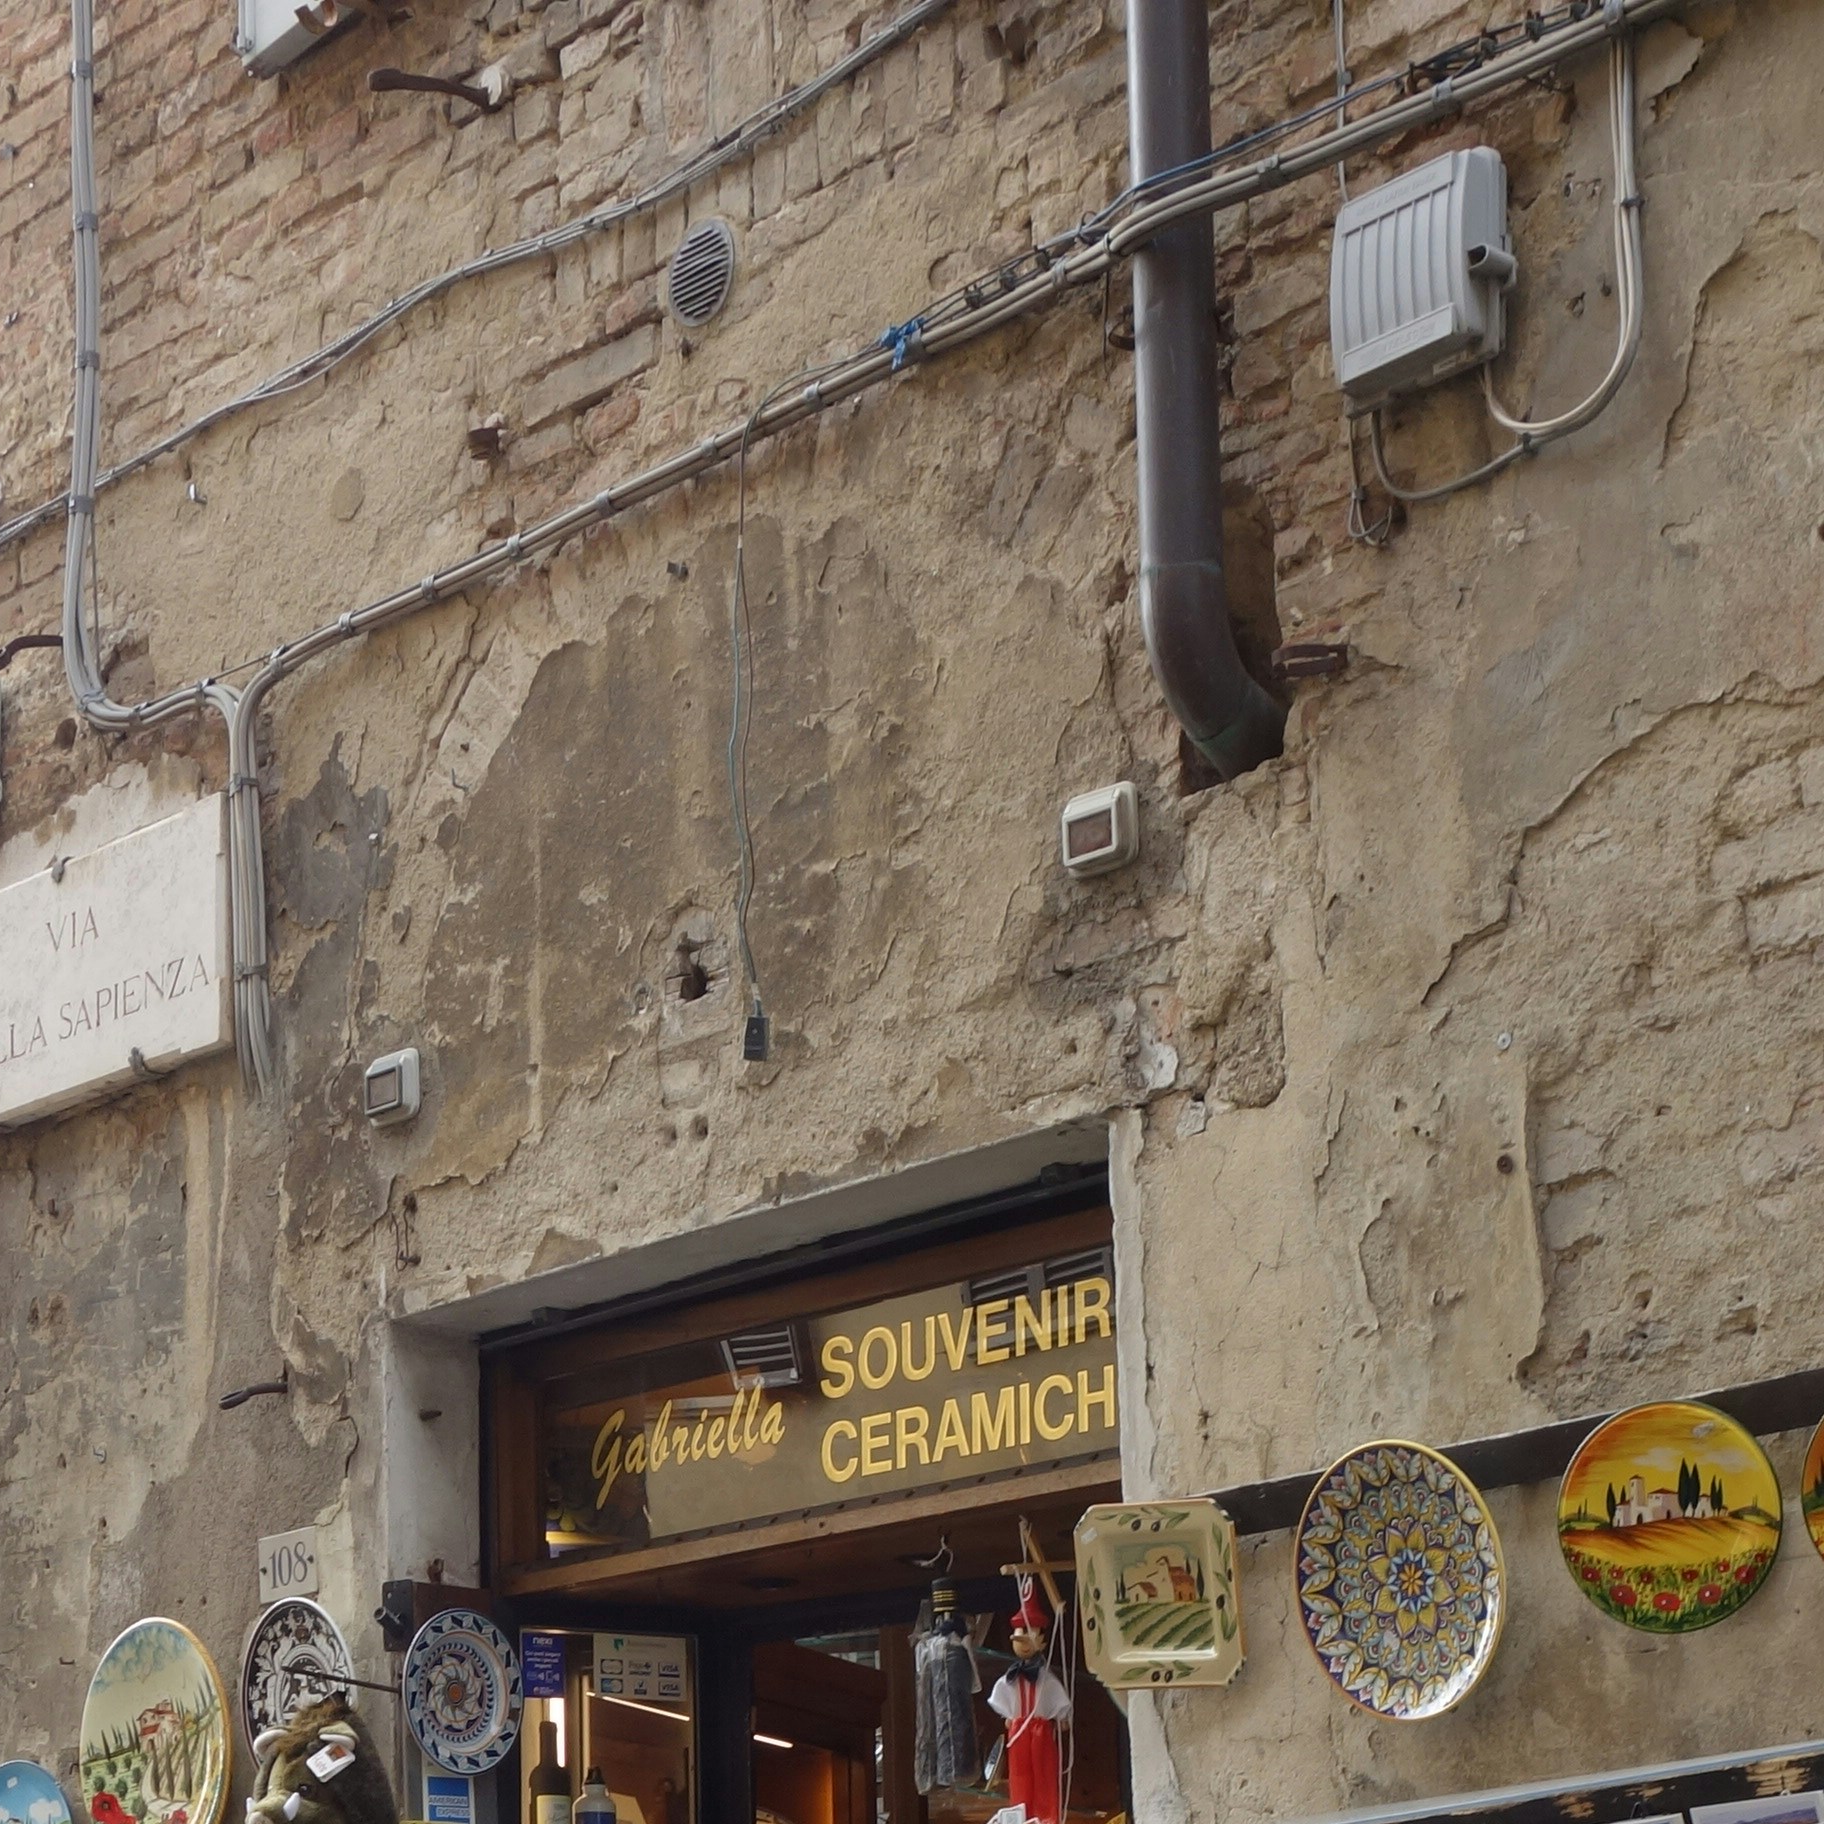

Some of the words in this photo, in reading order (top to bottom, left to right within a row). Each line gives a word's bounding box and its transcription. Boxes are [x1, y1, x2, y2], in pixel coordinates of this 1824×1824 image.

[46, 906, 99, 951] VIA
[59, 954, 210, 1041] SAPIENZA
[590, 1384, 786, 1510] Gabriella
[270, 1541, 308, 1590] 108
[429, 1796, 469, 1807] AMERICAN
